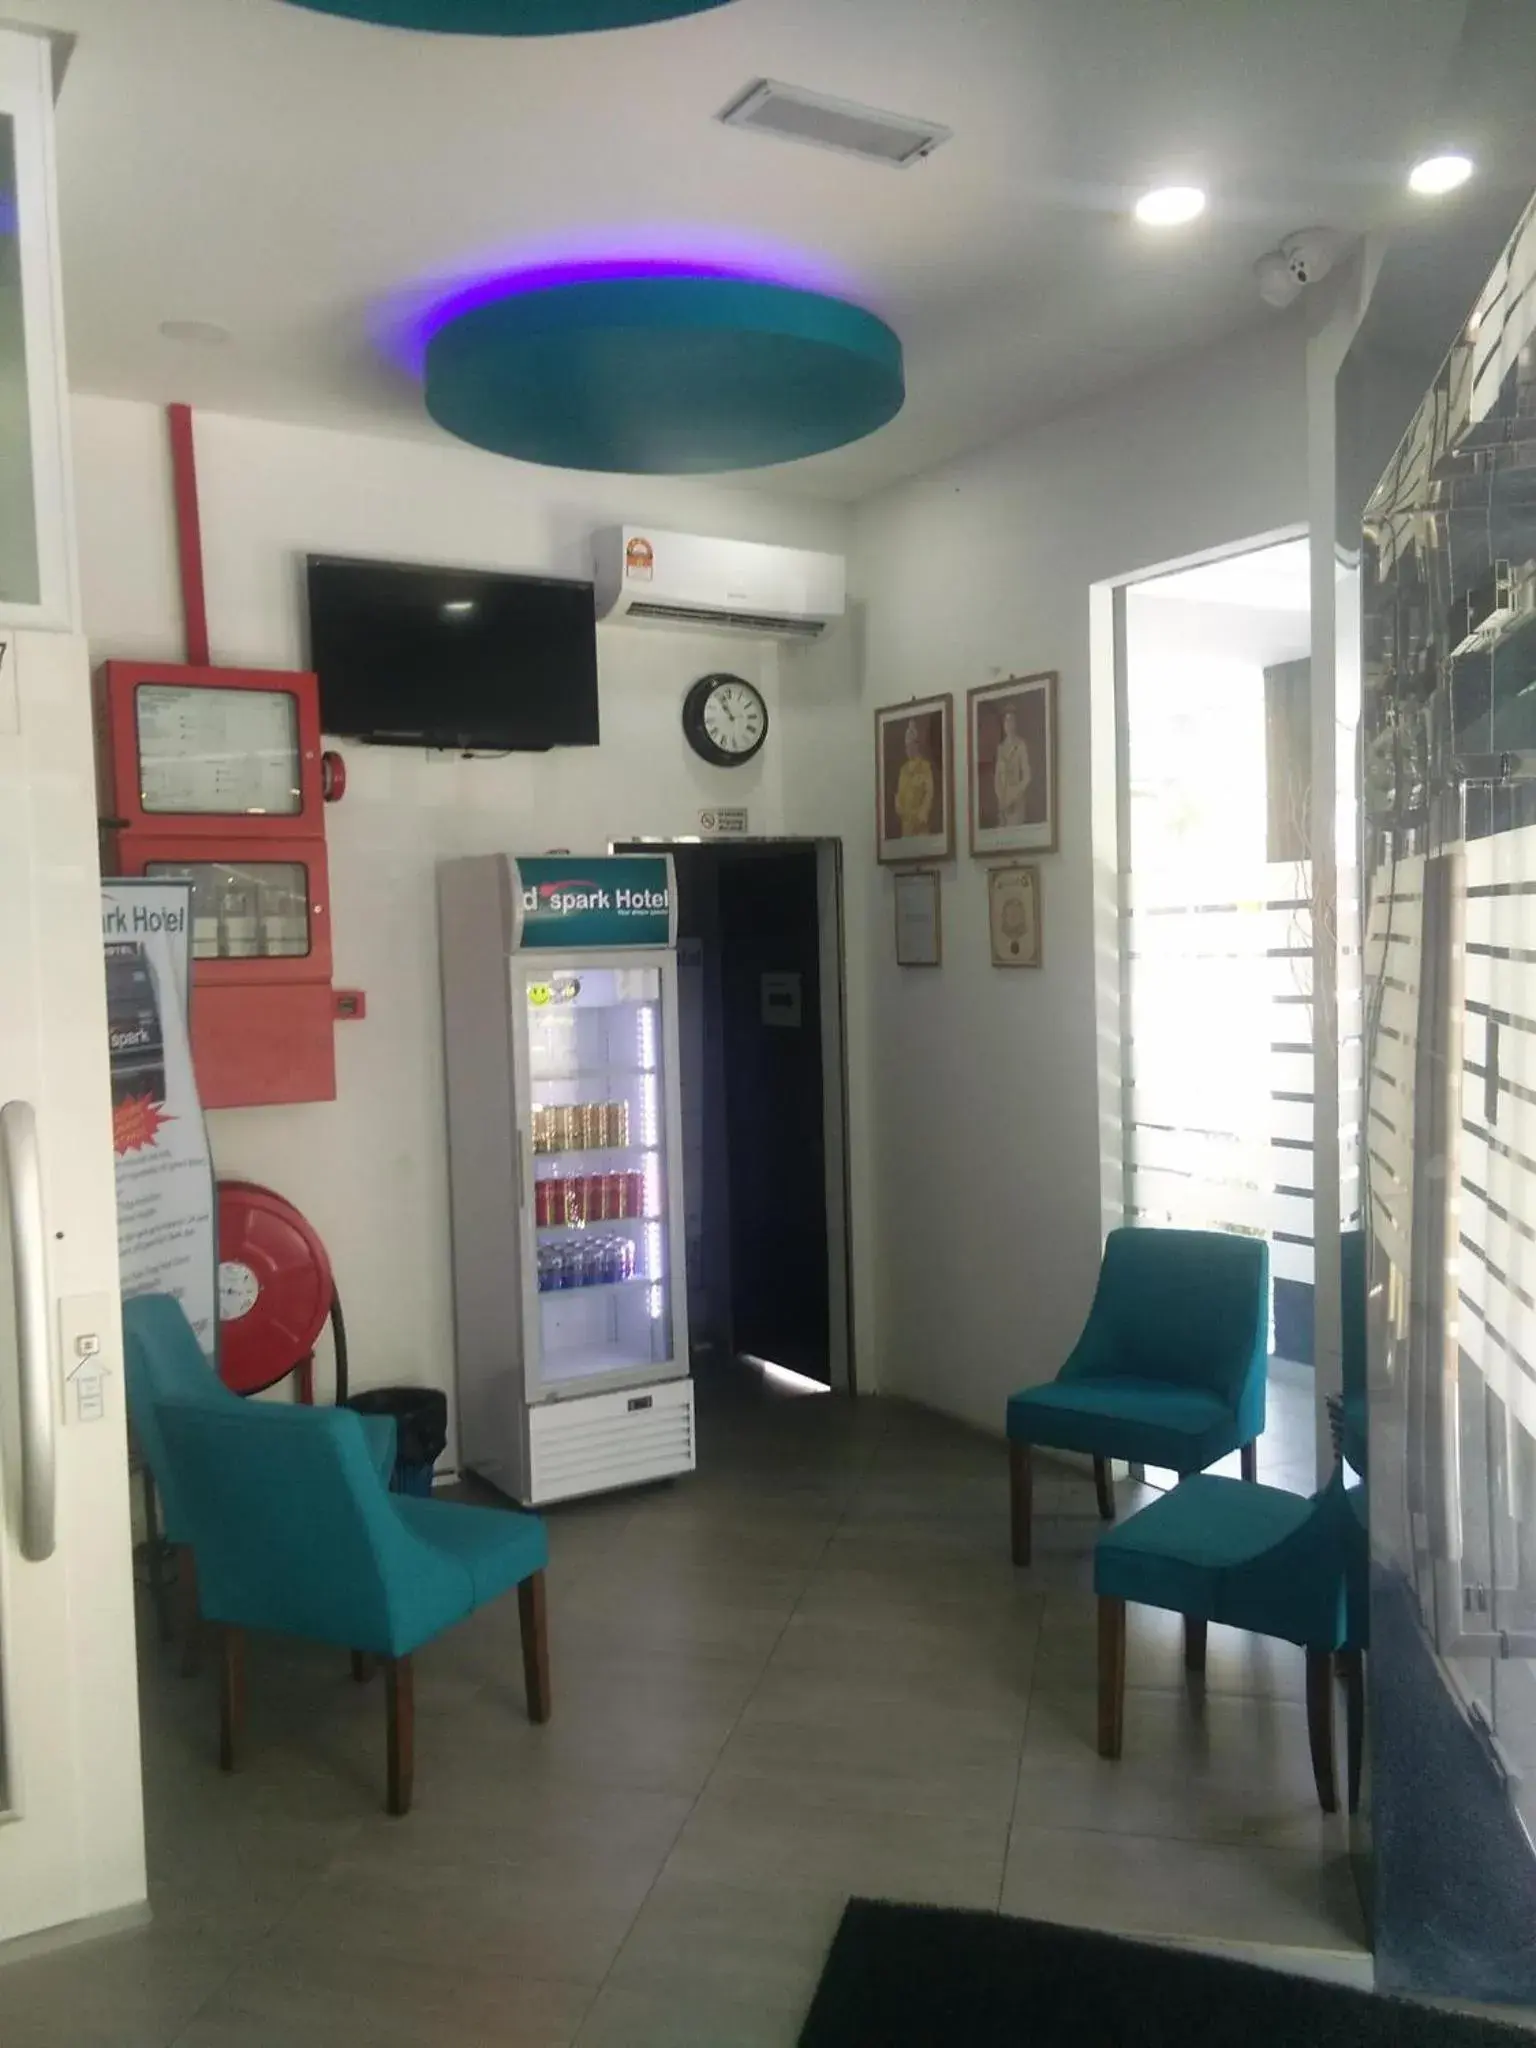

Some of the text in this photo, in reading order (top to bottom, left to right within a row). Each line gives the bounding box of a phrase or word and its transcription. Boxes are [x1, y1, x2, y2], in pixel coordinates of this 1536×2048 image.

[550, 888, 610, 915] spark
[615, 889, 669, 909] Hotel
[133, 905, 184, 933] Hotel
